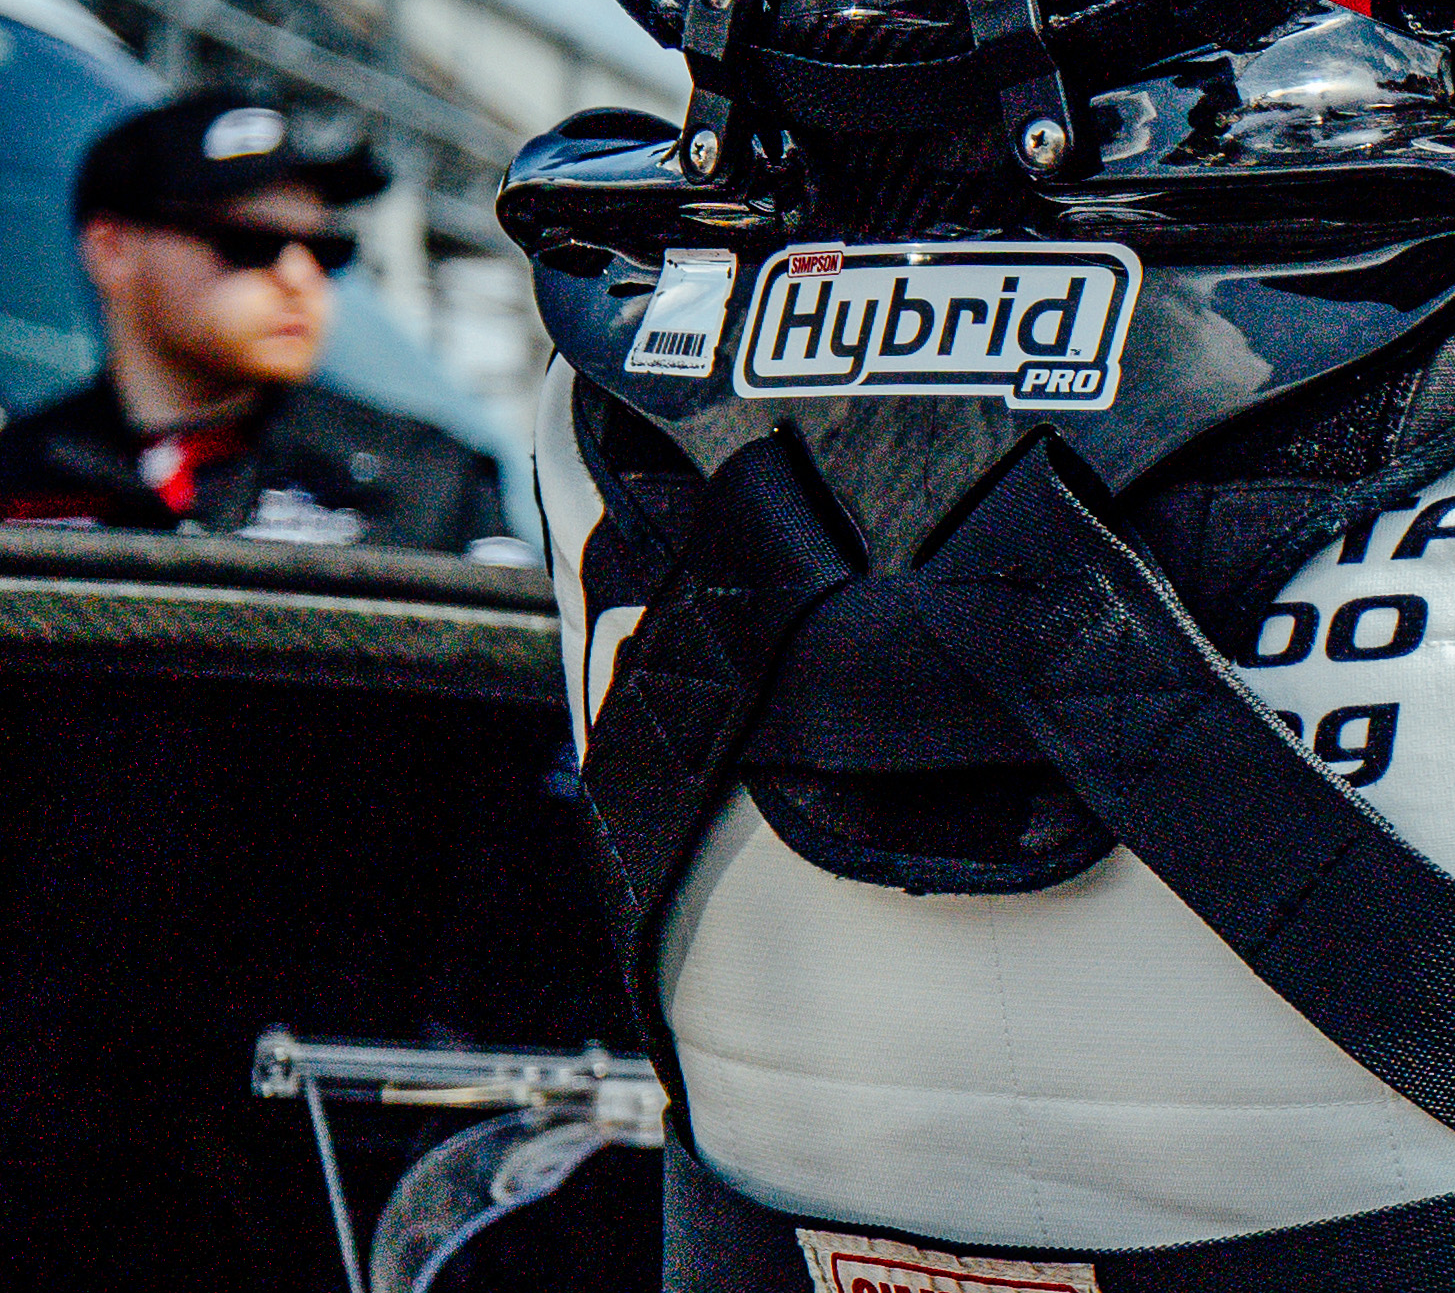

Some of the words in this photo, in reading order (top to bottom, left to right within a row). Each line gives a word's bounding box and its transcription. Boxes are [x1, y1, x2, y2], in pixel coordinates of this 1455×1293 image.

[791, 254, 839, 274] SIMPSON
[771, 276, 1087, 380] Hybrid
[1020, 368, 1101, 393] PRO
